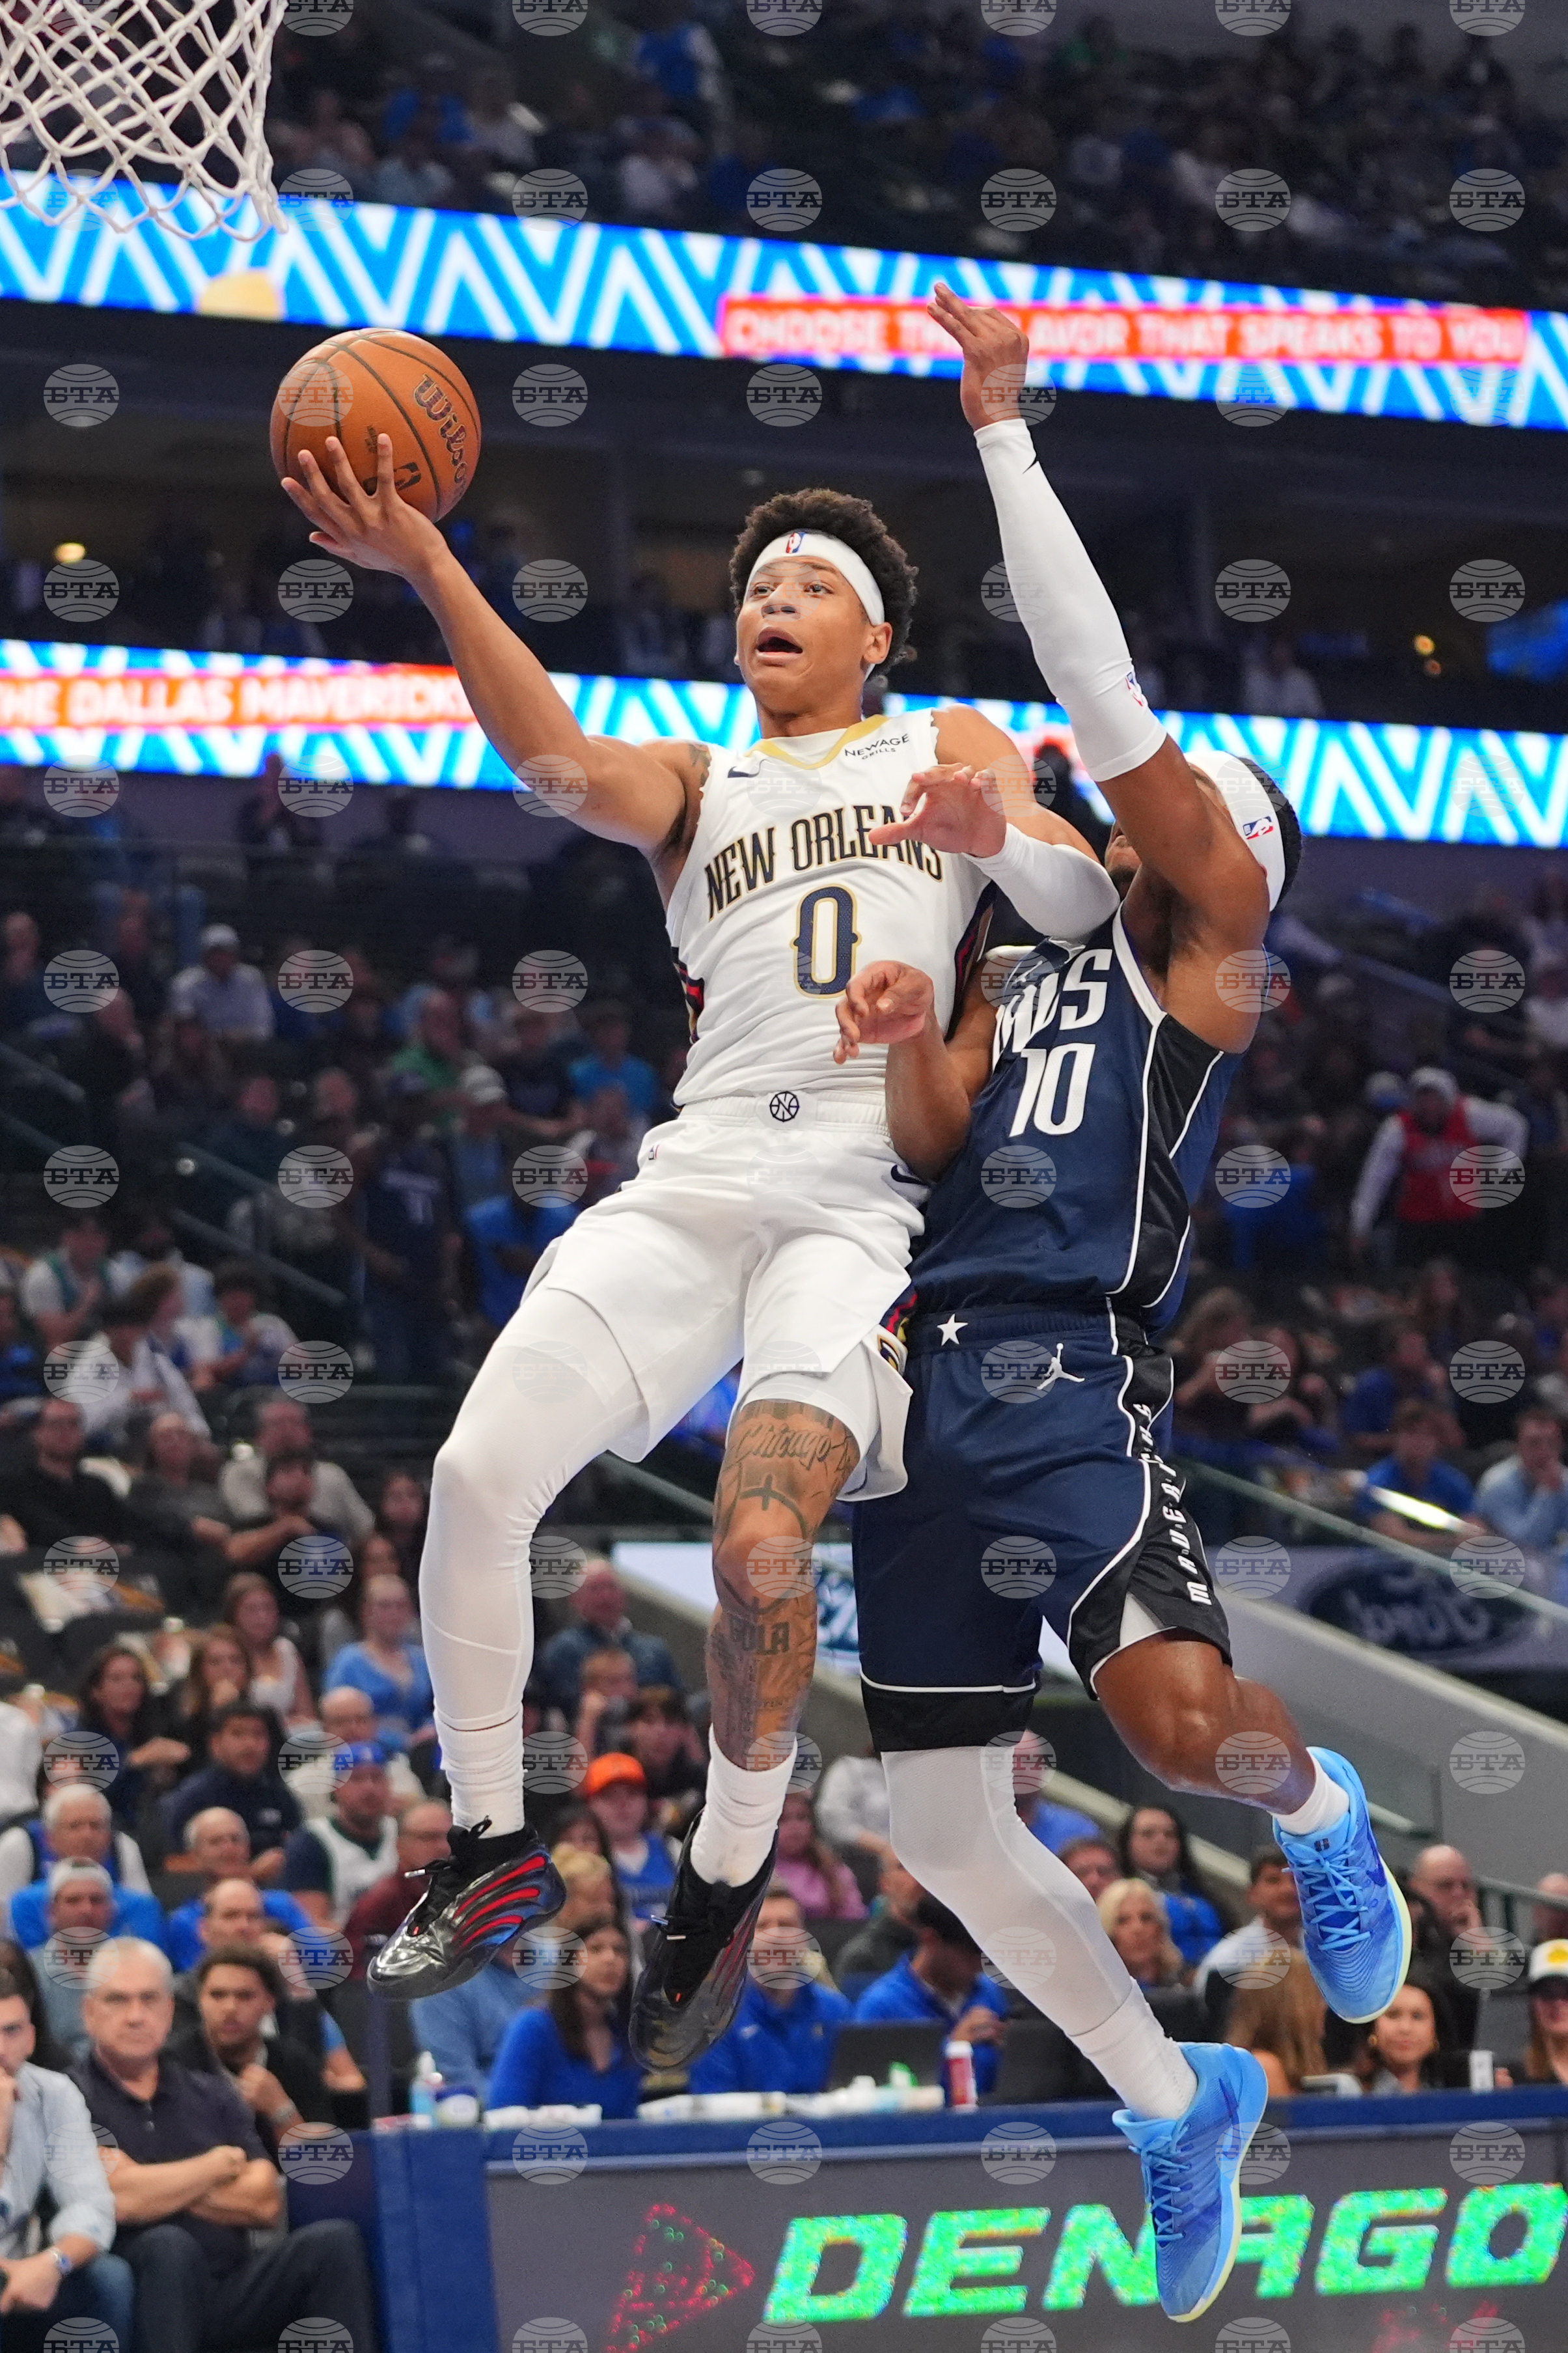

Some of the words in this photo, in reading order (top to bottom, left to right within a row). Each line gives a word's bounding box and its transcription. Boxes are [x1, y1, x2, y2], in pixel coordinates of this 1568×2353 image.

[413, 372, 469, 493] Wilso
[0, 679, 60, 722] HE
[68, 679, 234, 722] DALLAS
[844, 733, 909, 757] NEWAGE
[861, 747, 896, 760] GRILLS
[705, 826, 775, 922] NEW
[790, 884, 862, 998] 0
[1009, 1042, 1096, 1137] 10
[763, 2182, 1568, 2325] DENAGO
